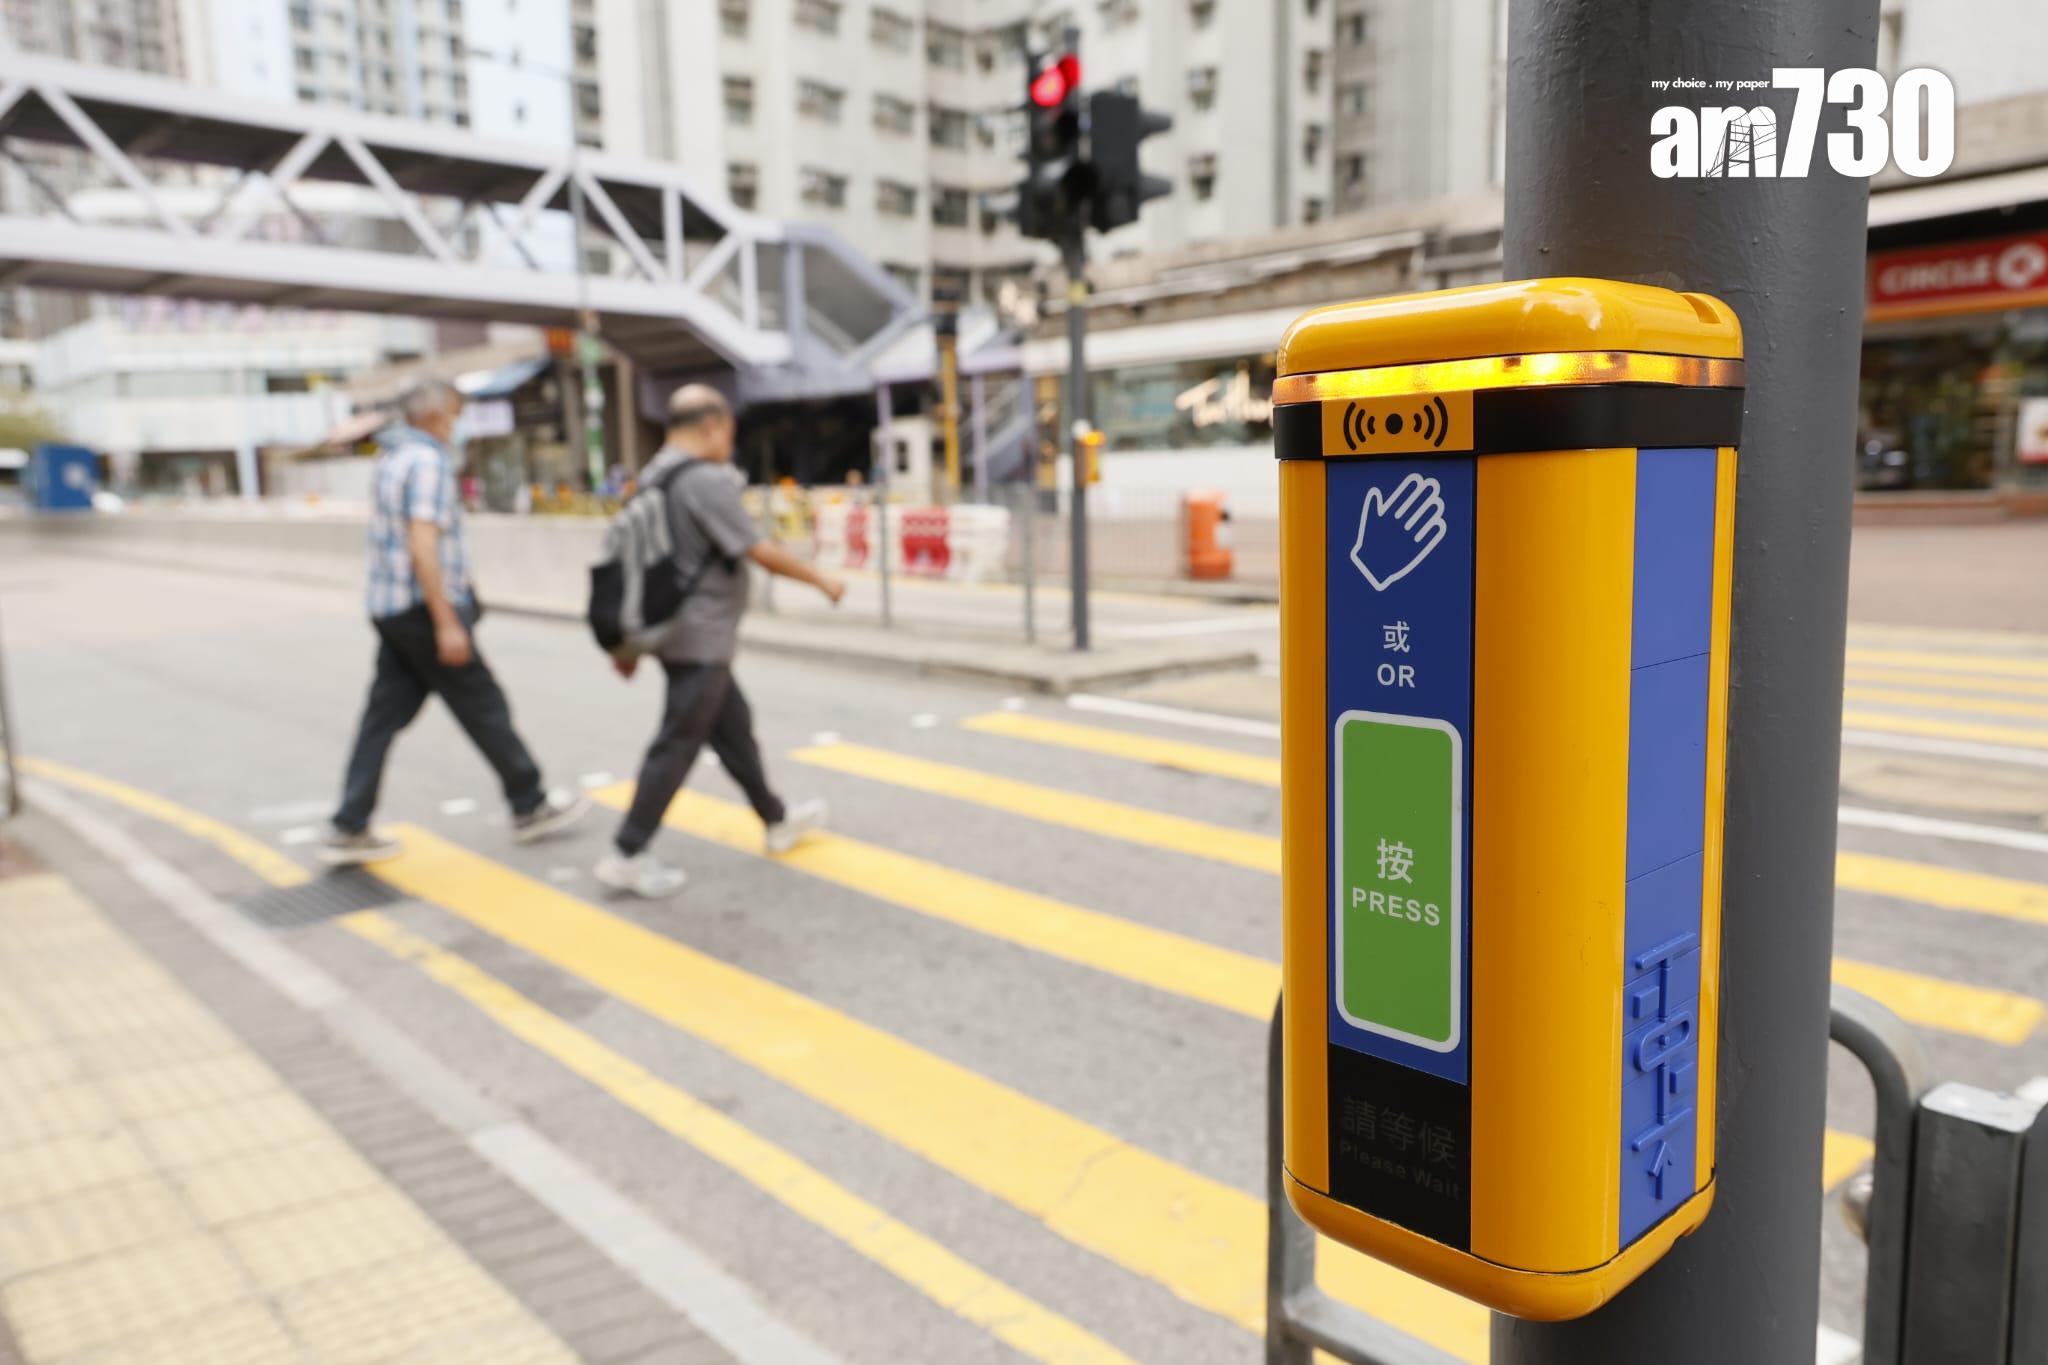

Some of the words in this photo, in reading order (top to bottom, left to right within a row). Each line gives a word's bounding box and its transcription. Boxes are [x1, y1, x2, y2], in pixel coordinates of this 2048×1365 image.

[1382, 621, 1410, 653] 或
[1377, 663, 1415, 688] OR
[1376, 838, 1414, 884] 按
[1352, 887, 1440, 926] PRESS
[1343, 1096, 1456, 1169] 請等候
[1340, 1138, 1407, 1179] Please
[1413, 1166, 1459, 1200] Wait
